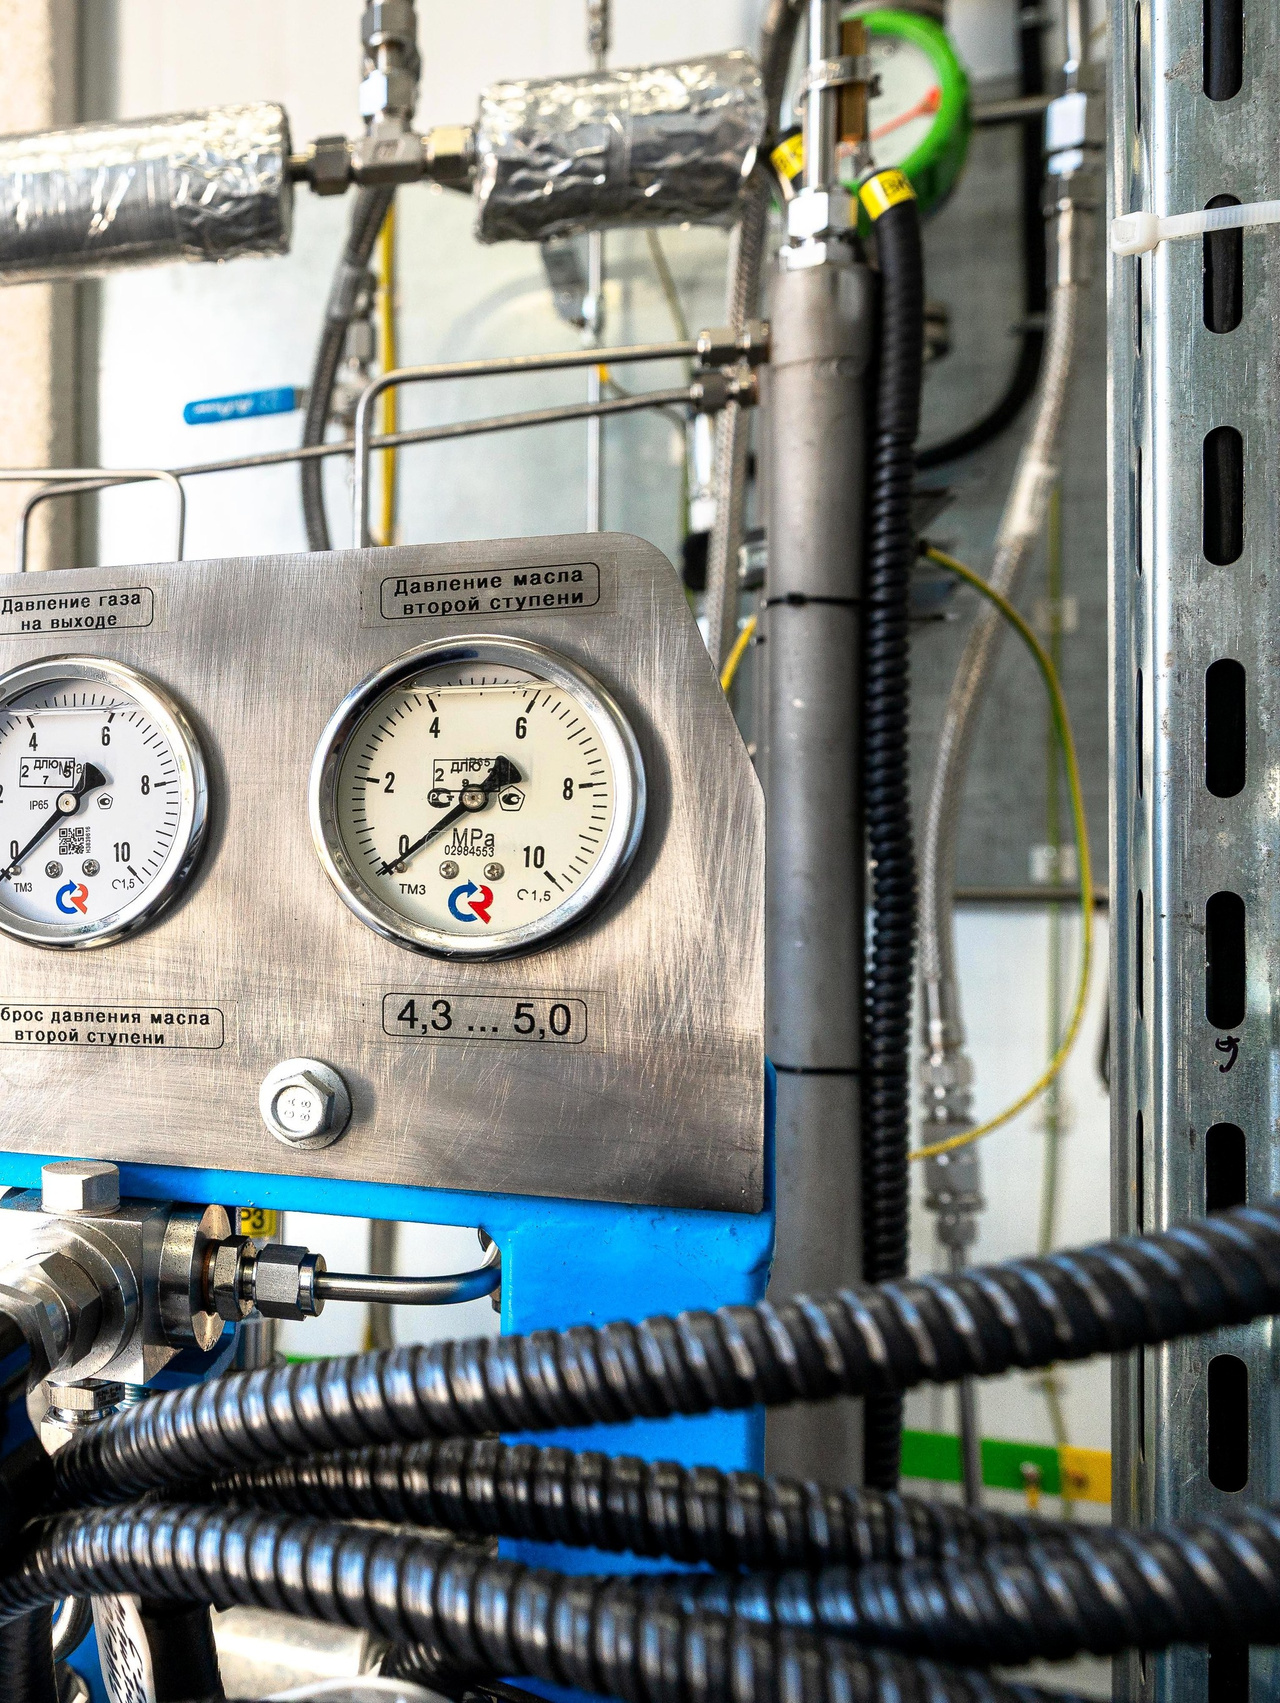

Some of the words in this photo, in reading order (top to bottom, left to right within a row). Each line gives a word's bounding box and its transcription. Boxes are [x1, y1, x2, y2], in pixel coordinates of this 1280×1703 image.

[394, 576, 503, 596] Давление
[513, 569, 584, 587] масла
[1, 597, 91, 615] Давление
[99, 593, 141, 607] газа
[403, 596, 480, 616] второй
[489, 592, 584, 612] ступени
[21, 619, 42, 631] на
[50, 614, 117, 630] выходе
[101, 726, 111, 746] 6
[429, 716, 441, 738] 4
[515, 716, 527, 738] 6
[29, 732, 38, 751] 4
[34, 760, 58, 770] ДЛЮ
[141, 775, 150, 795] 8
[384, 772, 396, 793] 2
[563, 778, 574, 800] 8
[29, 800, 49, 810] IP65
[399, 835, 410, 856] 0
[452, 828, 495, 848] MPa
[10, 840, 19, 859] 0
[113, 842, 131, 862] 10
[444, 845, 495, 857] 02984553
[523, 846, 545, 868] 10
[51, 1008, 141, 1024] давления
[150, 1012, 210, 1025] масла
[397, 999, 453, 1034] 4,3
[514, 1002, 571, 1039] 5,0
[14, 1028, 79, 1044] второй
[87, 1031, 165, 1046] ступени
